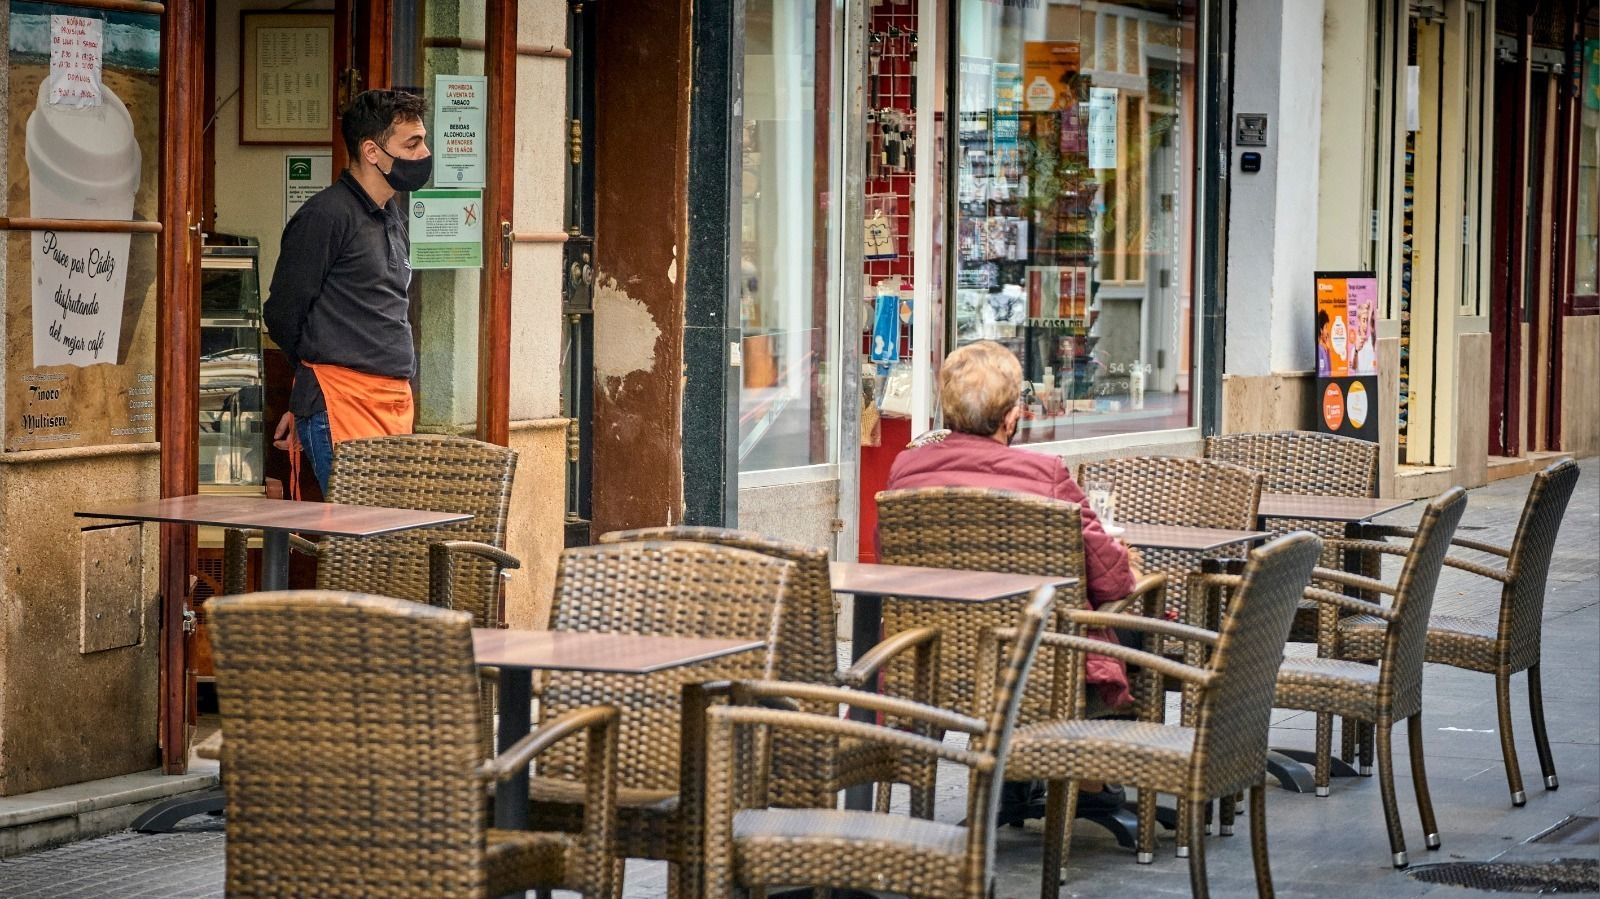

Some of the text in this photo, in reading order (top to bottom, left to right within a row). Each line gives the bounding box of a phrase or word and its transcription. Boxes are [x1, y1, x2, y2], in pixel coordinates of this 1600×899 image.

[43, 230, 115, 282] Pasee por Cádiz
[54, 283, 99, 320] disfrutando
[49, 319, 105, 360] del mejor café
[29, 385, 59, 407] Tinoco
[21, 413, 68, 434] Multiserv
